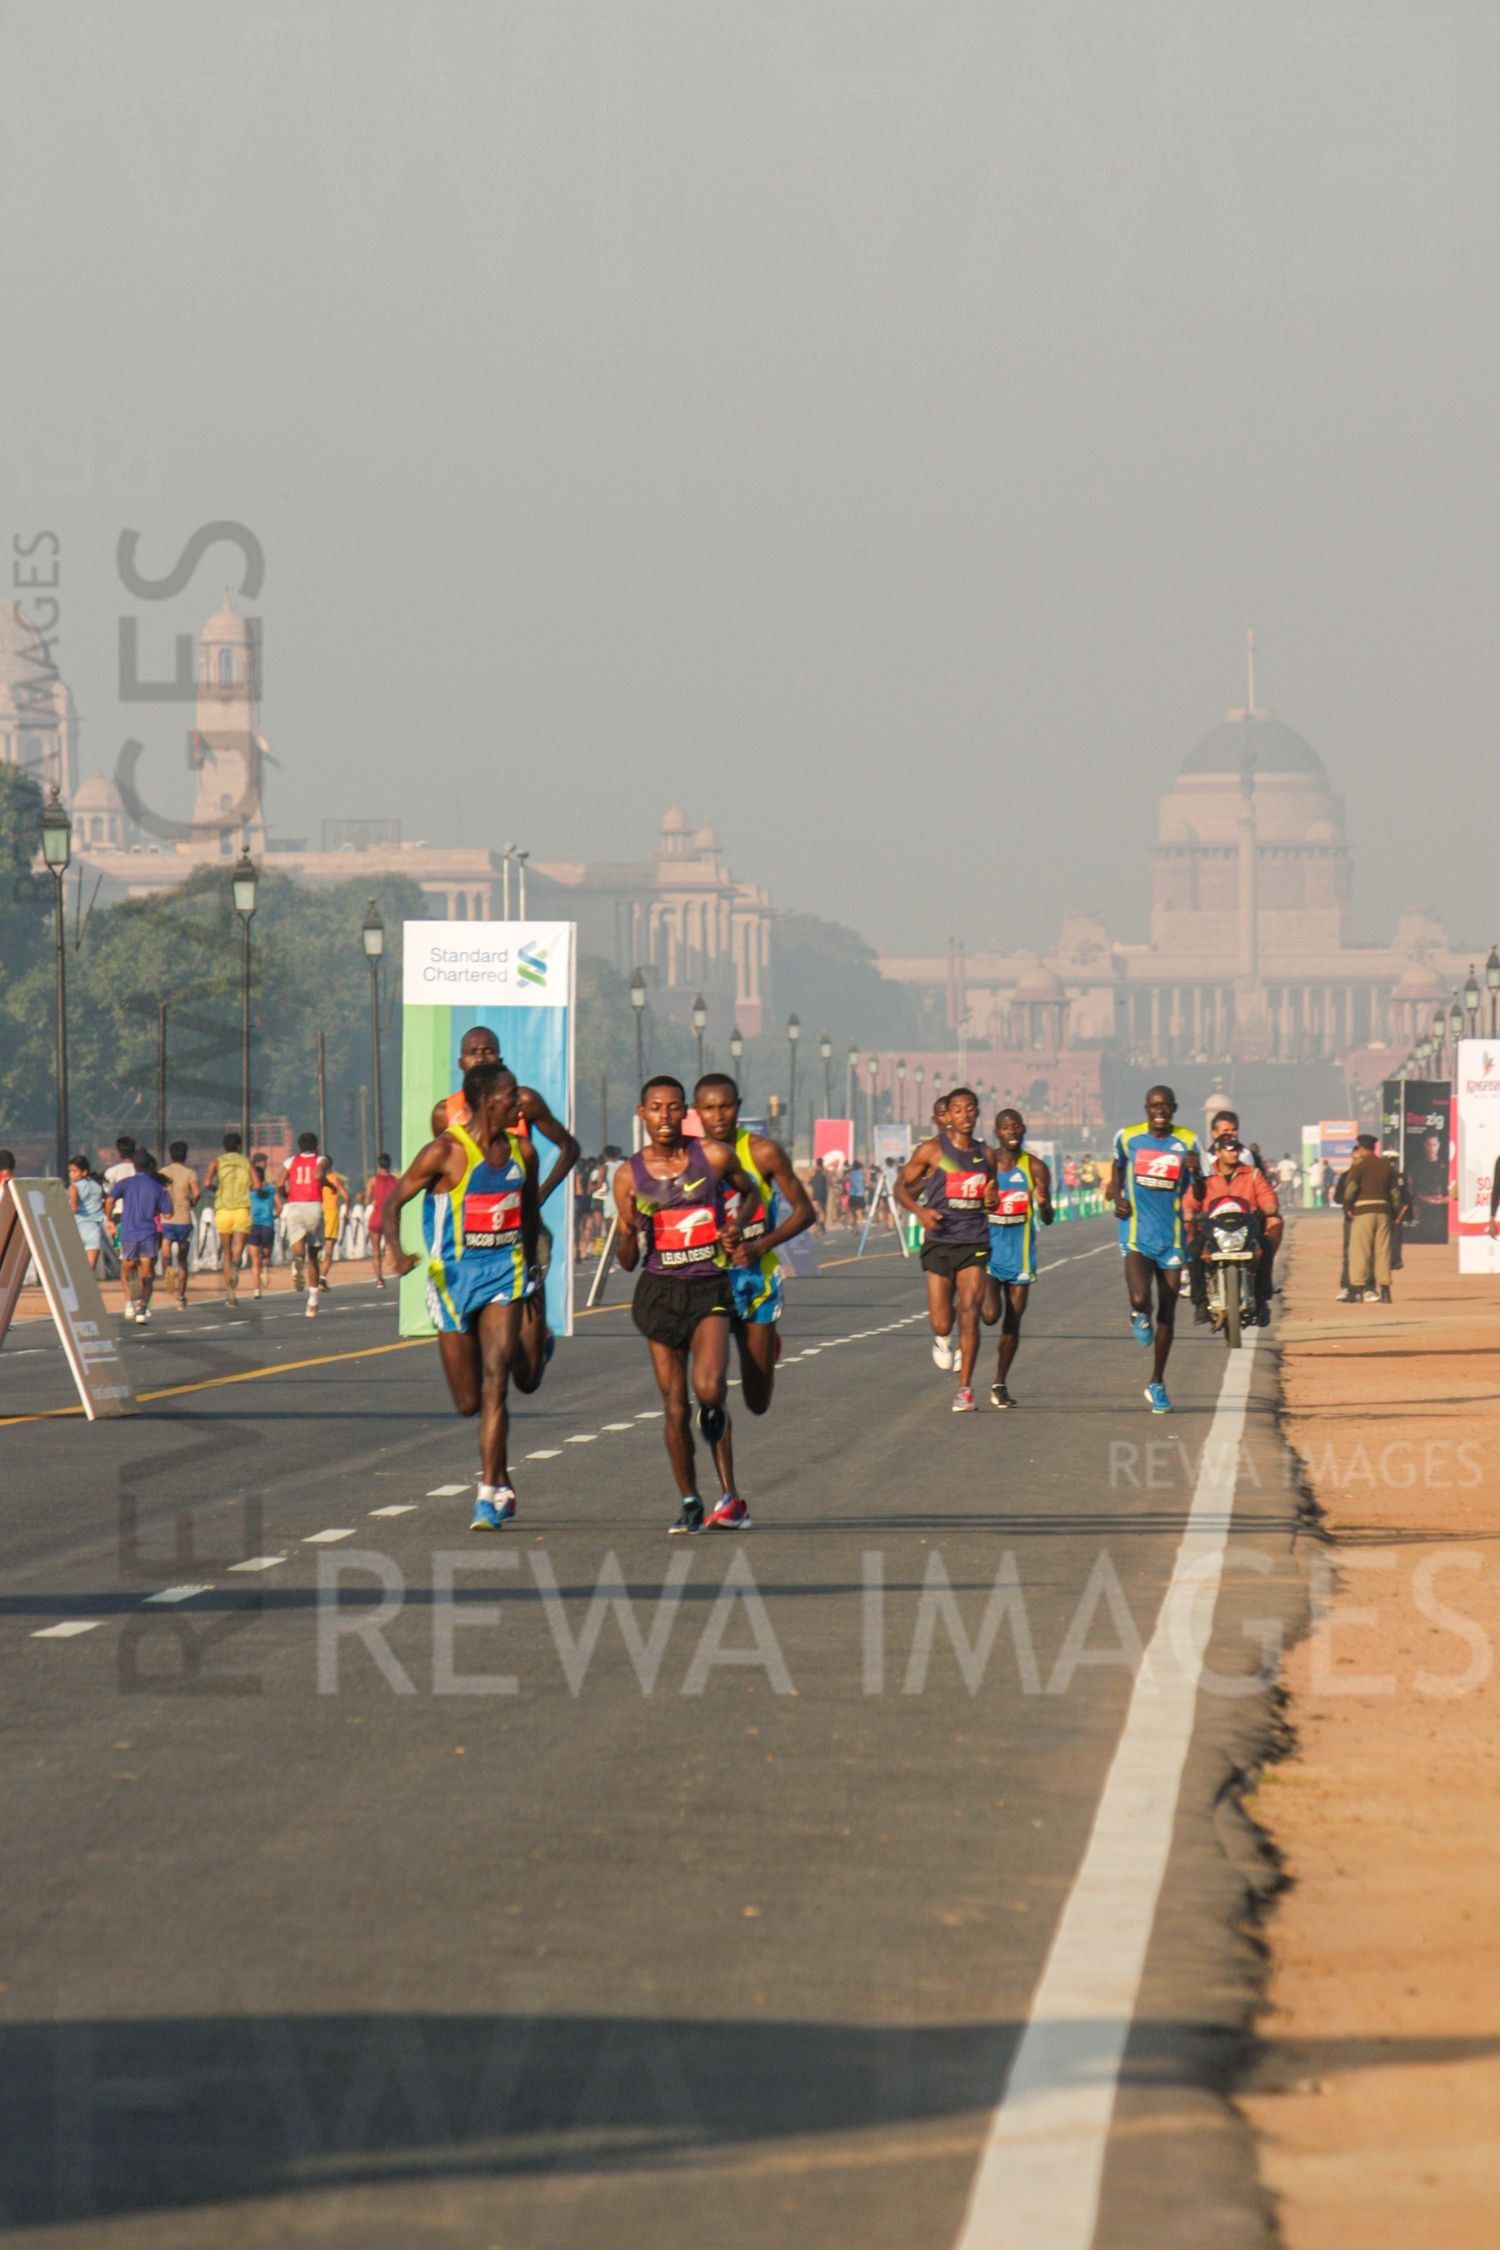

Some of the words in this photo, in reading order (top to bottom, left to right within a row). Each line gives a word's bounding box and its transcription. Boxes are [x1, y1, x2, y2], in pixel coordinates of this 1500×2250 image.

[430, 947, 509, 963] Standard
[423, 966, 509, 983] Chartered
[296, 1165, 311, 1185] 11
[960, 1184, 978, 1198] 15
[1002, 1201, 1014, 1214] 6
[491, 1211, 504, 1231] 9
